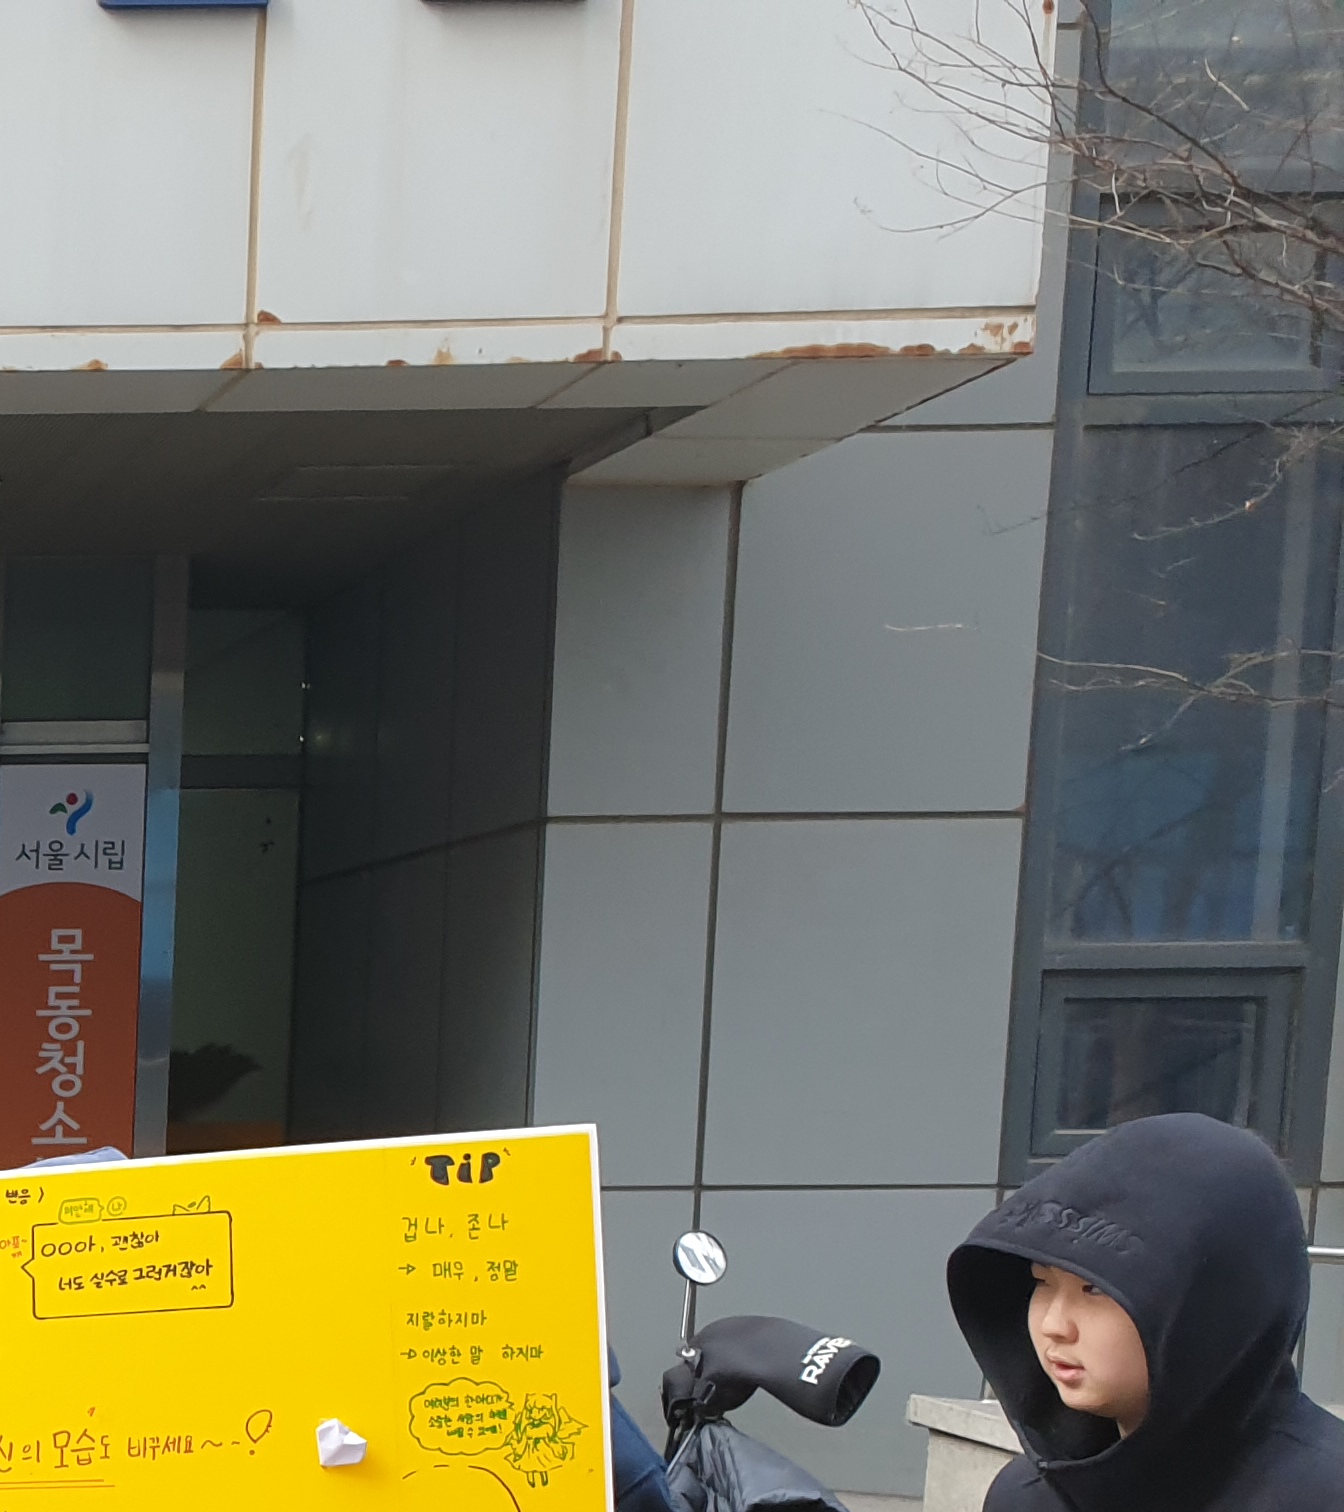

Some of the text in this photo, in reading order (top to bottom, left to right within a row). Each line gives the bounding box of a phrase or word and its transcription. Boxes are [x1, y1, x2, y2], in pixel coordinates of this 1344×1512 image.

[15, 840, 126, 871] 서울시립
[31, 928, 95, 1146] 목동청소
[486, 1259, 519, 1282] 정말
[52, 1428, 111, 1469] 모습도
